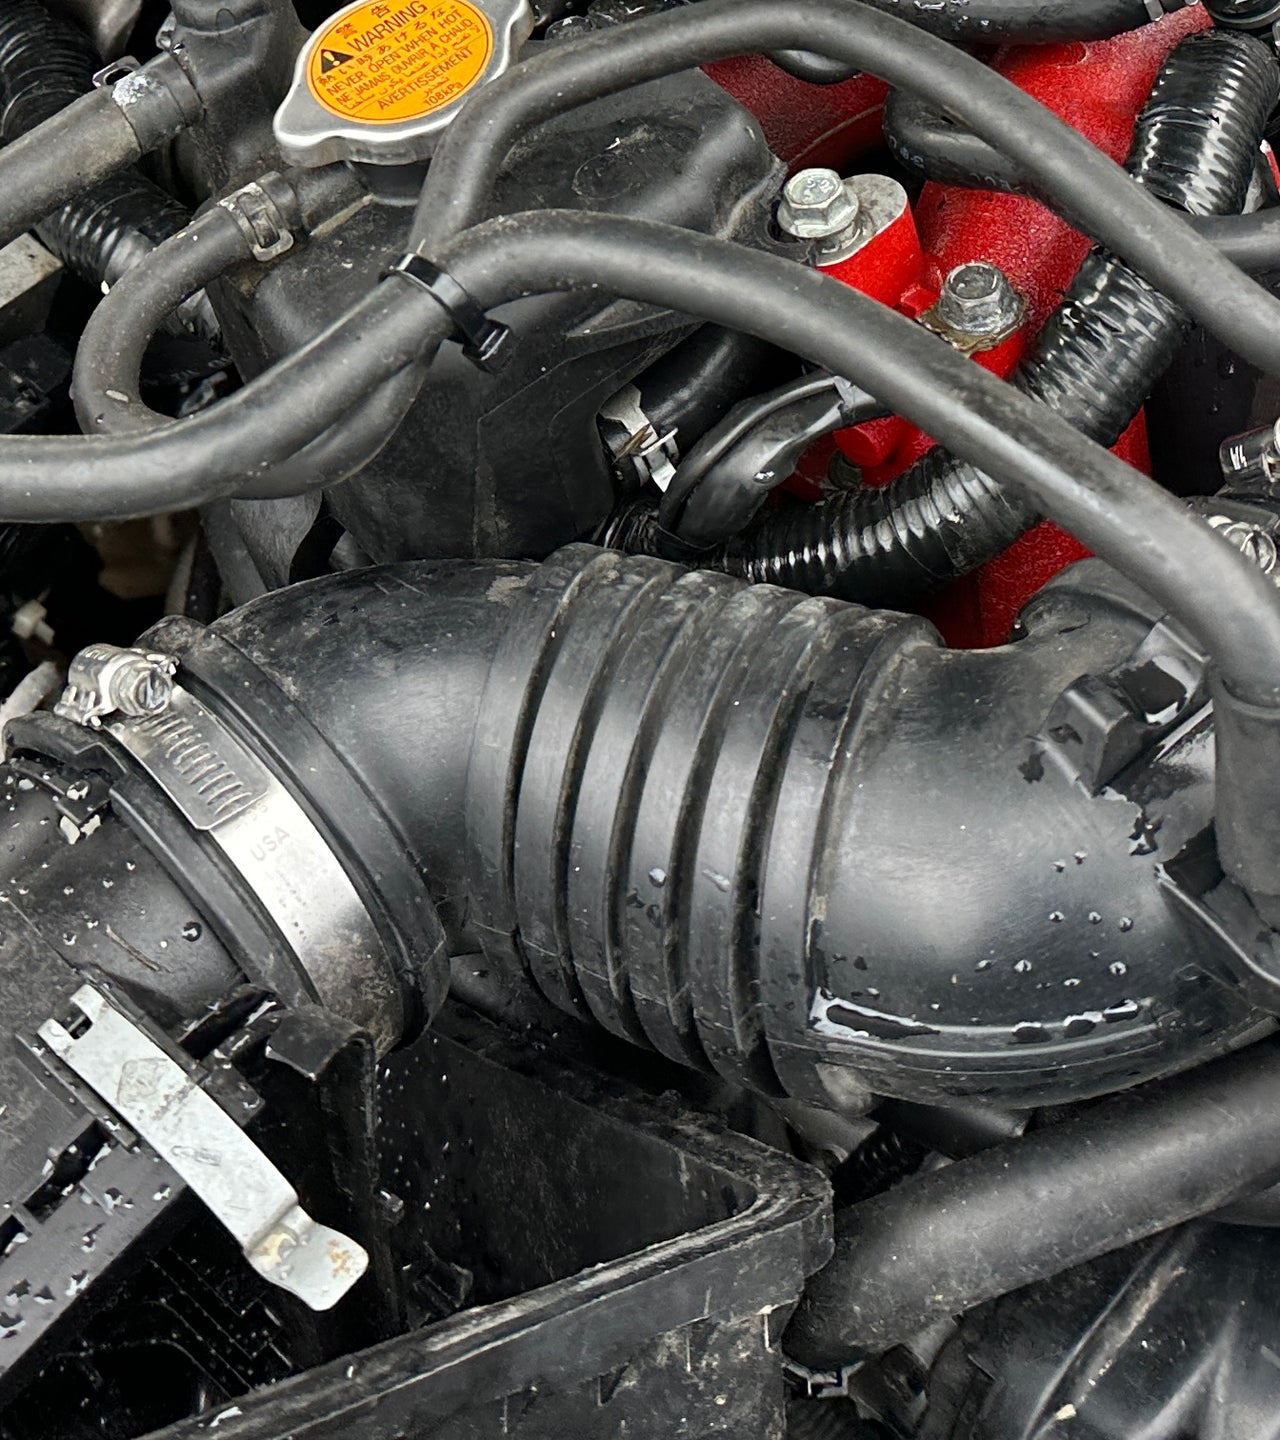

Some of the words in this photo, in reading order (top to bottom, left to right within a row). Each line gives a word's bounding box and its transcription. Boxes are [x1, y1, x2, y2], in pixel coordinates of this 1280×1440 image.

[326, 71, 368, 97] NEVER
[369, 51, 401, 74] OPEN
[400, 26, 438, 53] WHEN
[438, 10, 464, 29] HOT
[347, 0, 428, 53] WARNING
[336, 92, 352, 106] NE
[355, 73, 391, 96] JAMAIS
[392, 47, 429, 75] OUVRIR
[439, 18, 474, 44] CHAUD
[377, 45, 474, 111] AVERTISSEMENT
[423, 81, 464, 107] 108kPa
[249, 825, 291, 862] USA
